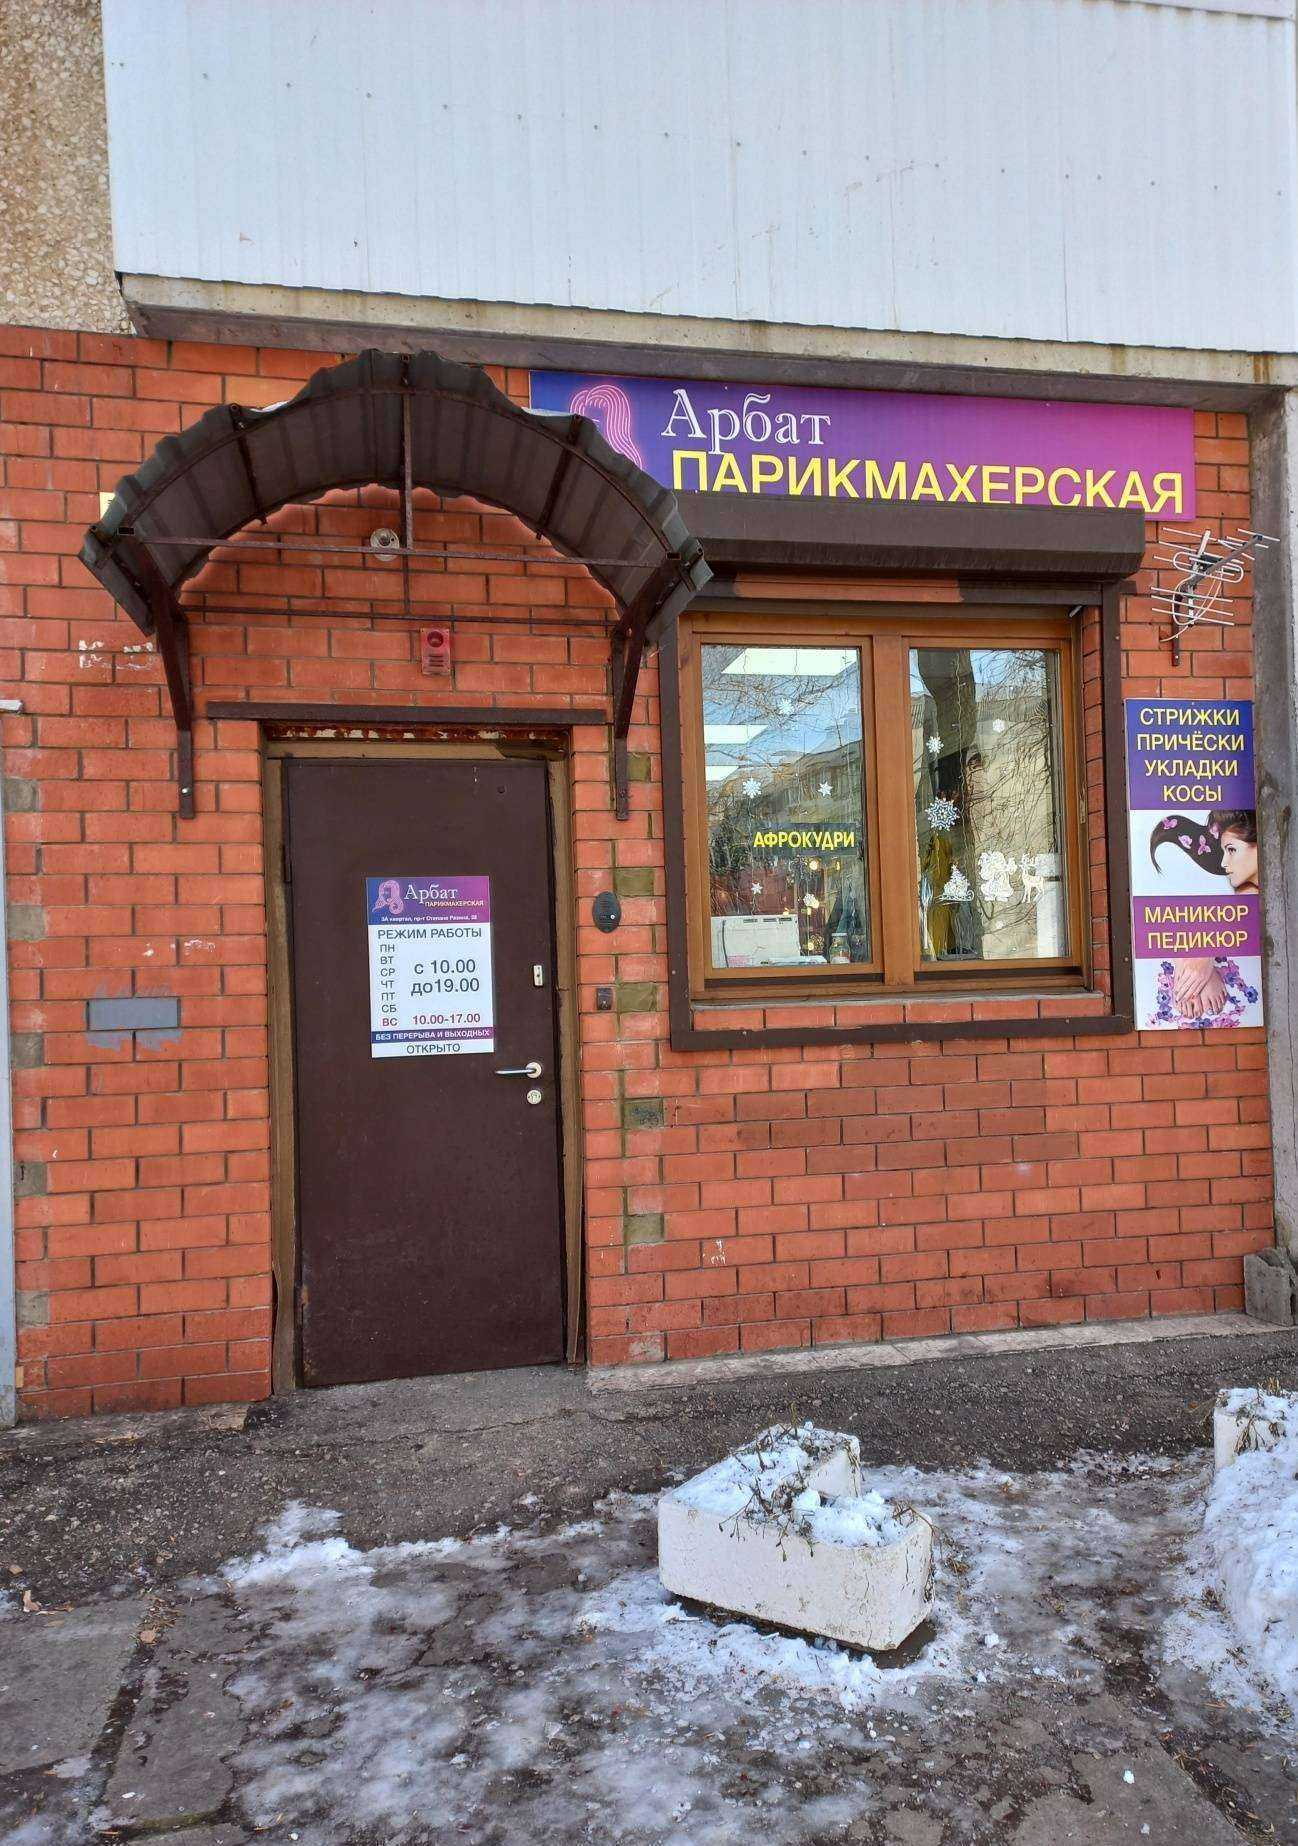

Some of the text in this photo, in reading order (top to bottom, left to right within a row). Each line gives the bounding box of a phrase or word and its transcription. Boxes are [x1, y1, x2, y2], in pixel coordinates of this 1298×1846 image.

[661, 388, 831, 455] Арбат
[672, 449, 1184, 514] ПАРИКМАХЕРСКАЯ
[1140, 707, 1240, 726] СТРИЖКИ
[1136, 731, 1245, 751] ПРИЧЁСКИ
[1144, 759, 1238, 780] УКЛАДКИ
[1163, 785, 1222, 802] КОСЫ
[753, 831, 855, 851] АФРОКУДРИ
[403, 884, 458, 904] Арбат
[424, 900, 485, 908] ПАРИКМАХЕРСКАЯ
[1144, 905, 1249, 923] МАНИКЮР
[378, 928, 482, 939] РЕЖИМ РАБОТЫ
[380, 944, 395, 952] ПН
[1148, 930, 1248, 952] ПЕДИКЮР
[380, 956, 394, 965] ВТ
[431, 959, 476, 974] 10.00
[380, 968, 396, 977] СР
[380, 980, 395, 989] ЧТ
[381, 992, 396, 1001] ПТ
[382, 1004, 397, 1013] СБ
[382, 1013, 481, 1026] ВС 10.00-17.00
[375, 1033, 391, 1041] БЕЗ
[393, 1031, 436, 1040] ПЕРЕРЫВА
[444, 1029, 490, 1038] ВЫХОДНЫХ
[406, 1043, 461, 1054] ОТКРЫТО
